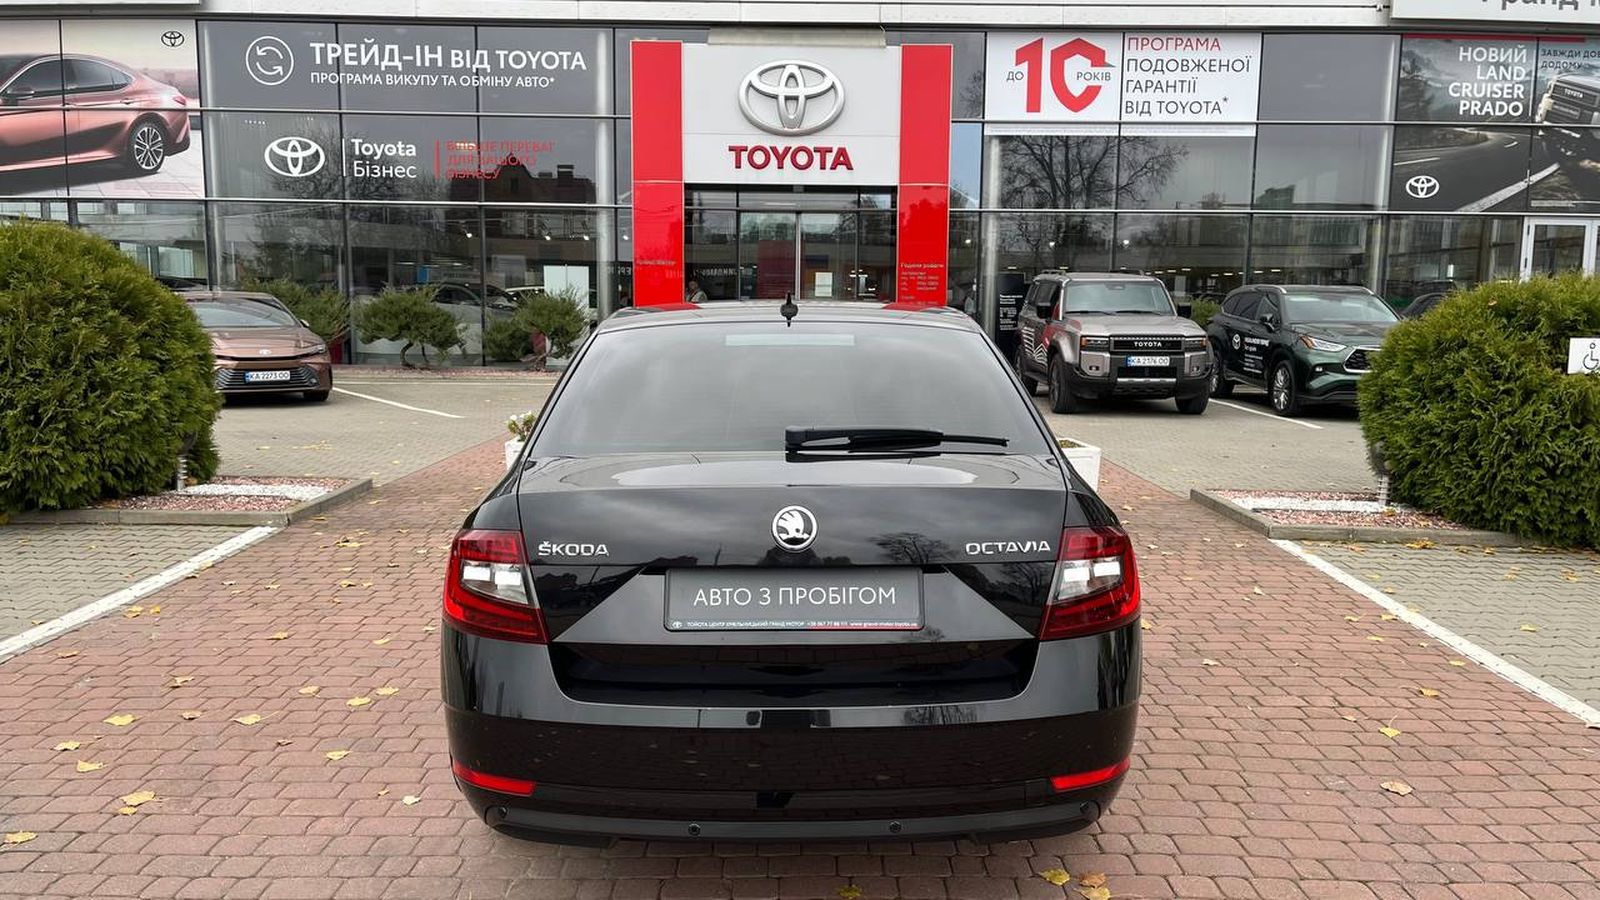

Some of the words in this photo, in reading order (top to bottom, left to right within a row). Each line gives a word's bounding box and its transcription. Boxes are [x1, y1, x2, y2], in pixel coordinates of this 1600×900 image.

[1127, 37, 1221, 51] ПРОГРАМА
[309, 38, 443, 71] ТРЕЙД-ІН
[450, 49, 491, 73] ВІД
[495, 50, 588, 71] TOYOTA
[1459, 45, 1527, 64] НОВИЙ
[1541, 49, 1581, 59] ЗАВЖДИ
[1126, 56, 1252, 75] ПОДОВЖЕНОЇ
[1476, 65, 1526, 81] LAND
[1541, 60, 1582, 70] ДОДОМУ
[310, 72, 383, 86] ПРОГРАМА
[385, 73, 439, 87] ВИКУПУ
[441, 74, 457, 87] ТА
[459, 75, 513, 88] ОБМІНУ
[1006, 71, 1024, 83] ДО
[1076, 71, 1112, 82] РОКІВ
[1125, 77, 1197, 94] ГАРАНТІЇ
[1448, 82, 1525, 99] CRUISER
[1564, 88, 1584, 99] TOYOTA
[1124, 100, 1152, 117] ВІД
[1459, 100, 1523, 117] PRADO
[350, 139, 417, 160] Toyota
[728, 144, 854, 171] TOYOTA
[353, 160, 417, 179] Бізнес
[538, 540, 610, 557] ŠKODA
[965, 540, 1051, 555] OCTAVIA
[693, 588, 752, 607] АВТО
[759, 588, 771, 606] З
[778, 586, 897, 605] ПРОБІГОМ
